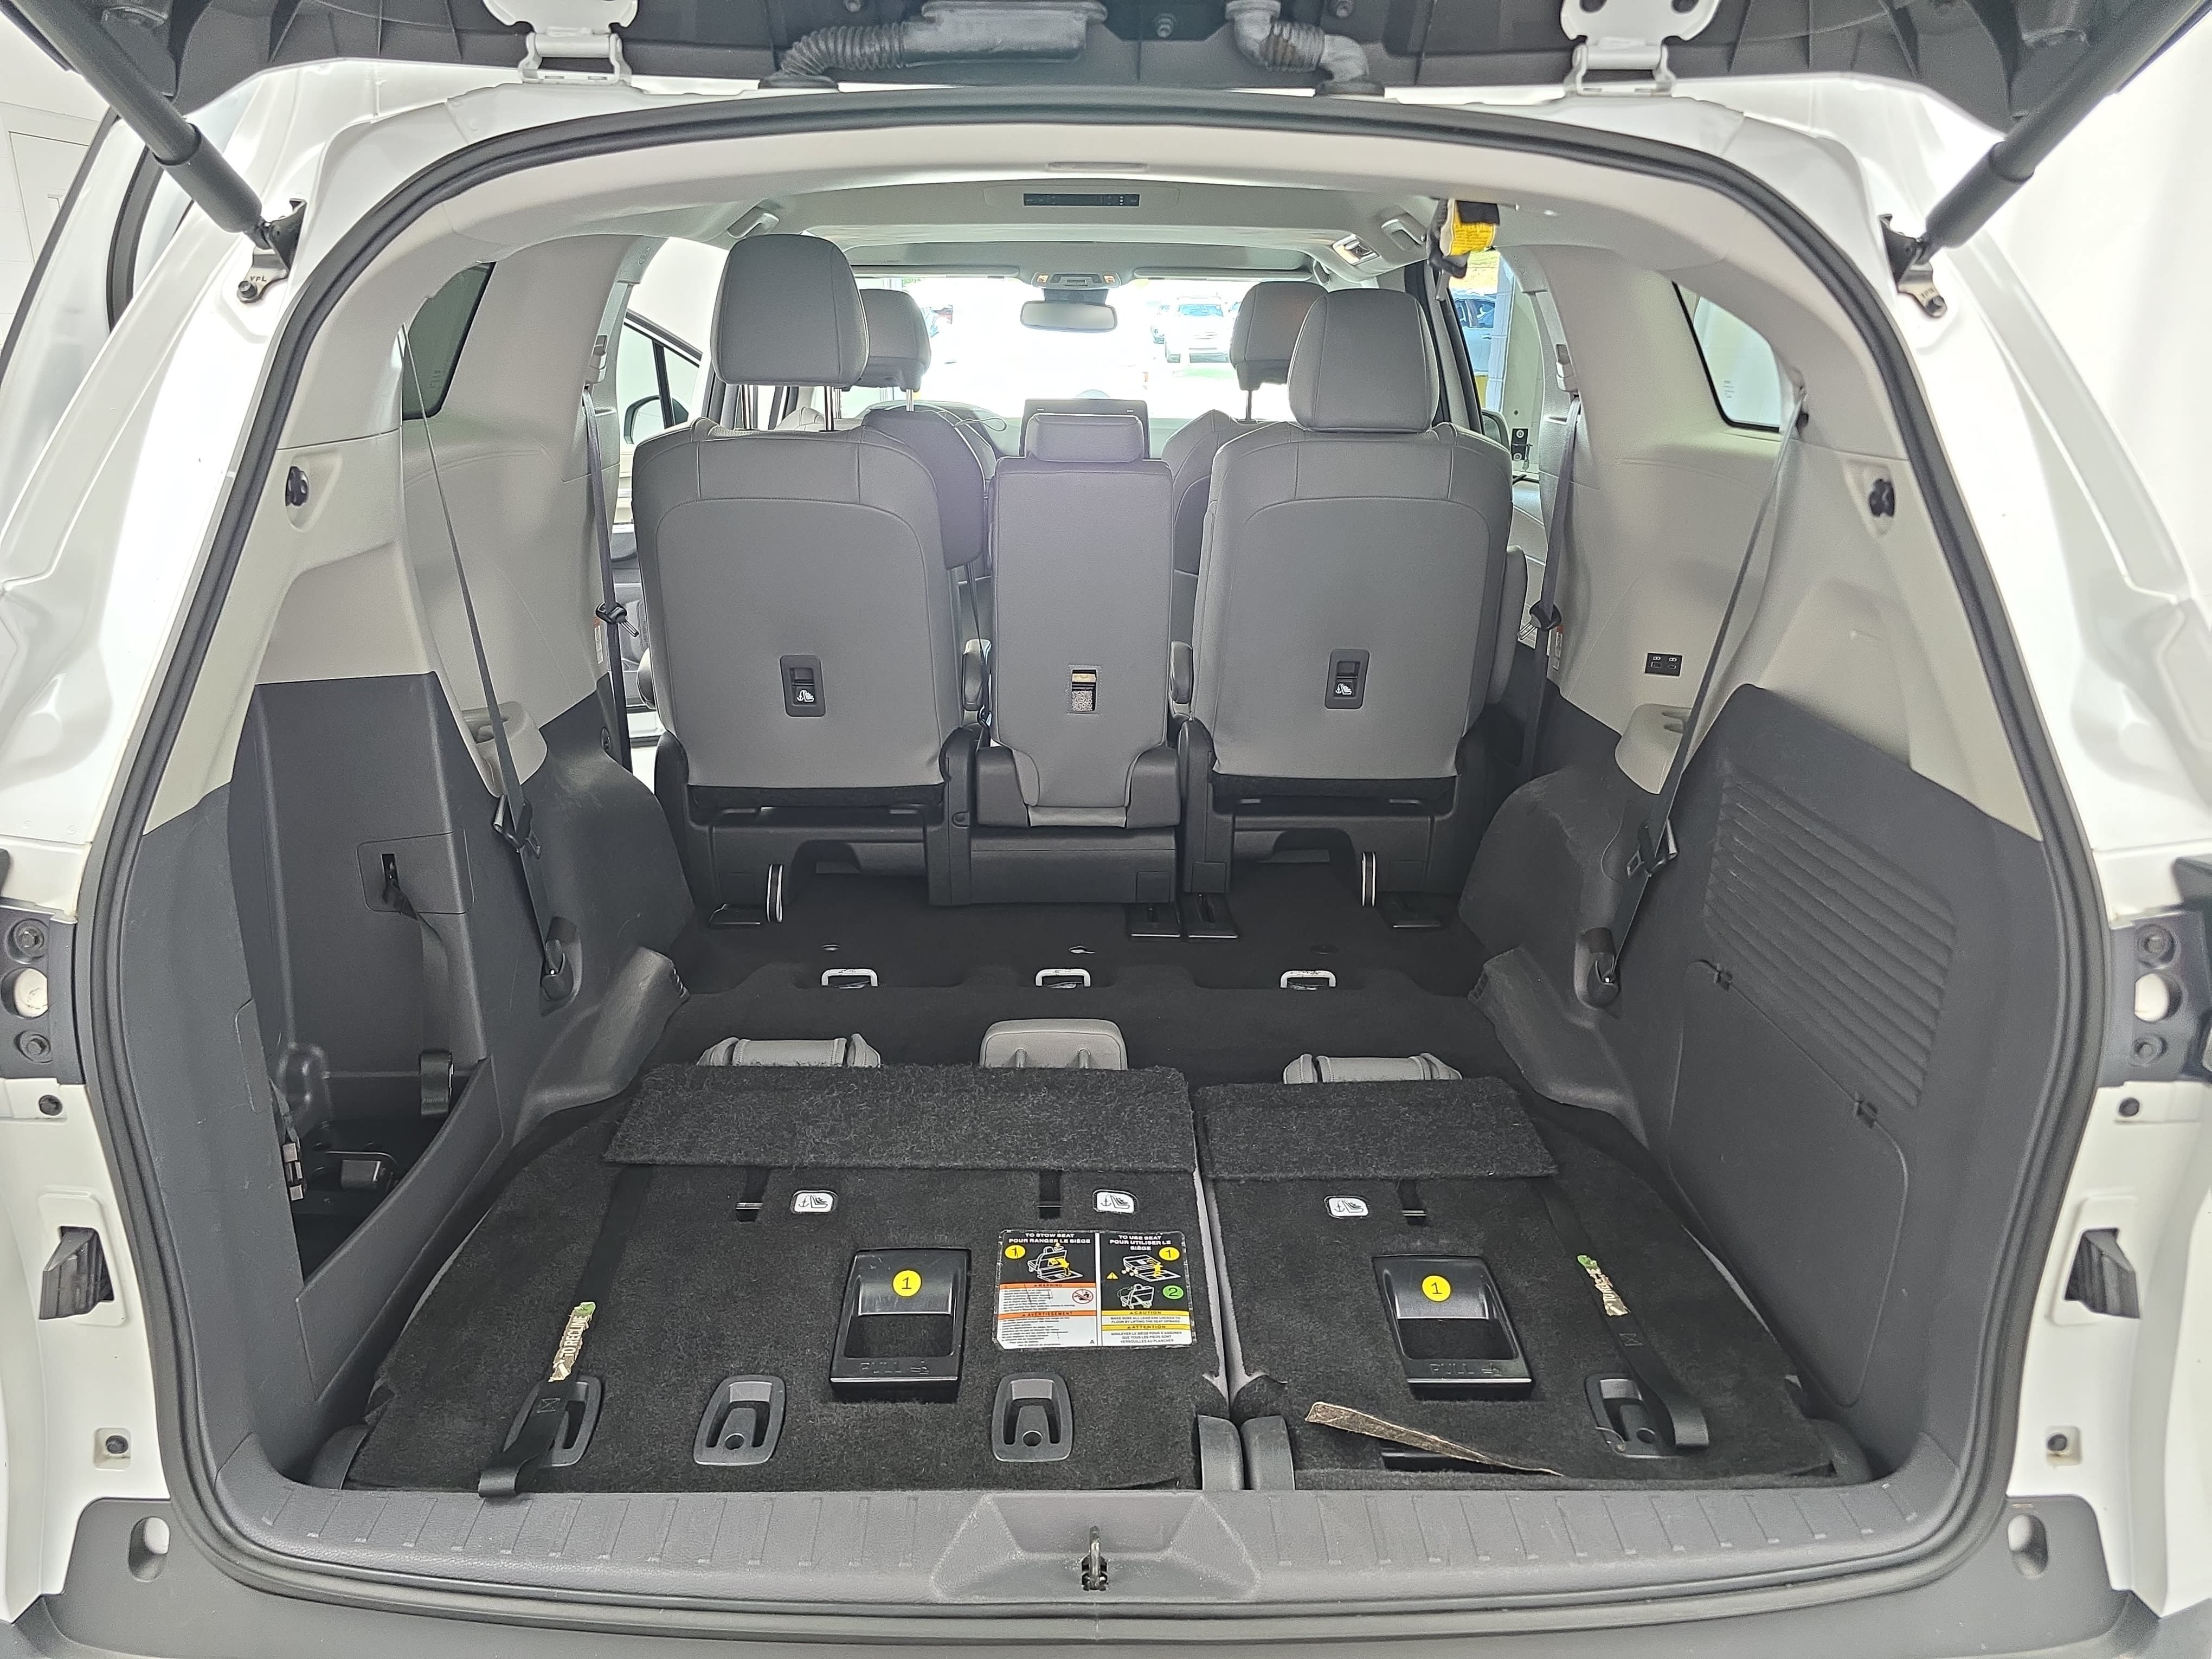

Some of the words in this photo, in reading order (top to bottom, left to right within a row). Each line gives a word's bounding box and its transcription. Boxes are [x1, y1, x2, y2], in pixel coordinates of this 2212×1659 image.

[902, 1277, 912, 1290] 1
[1431, 1282, 1443, 1295] 1
[1168, 1287, 1179, 1297] 2
[564, 1316, 588, 1347] RECLINE
